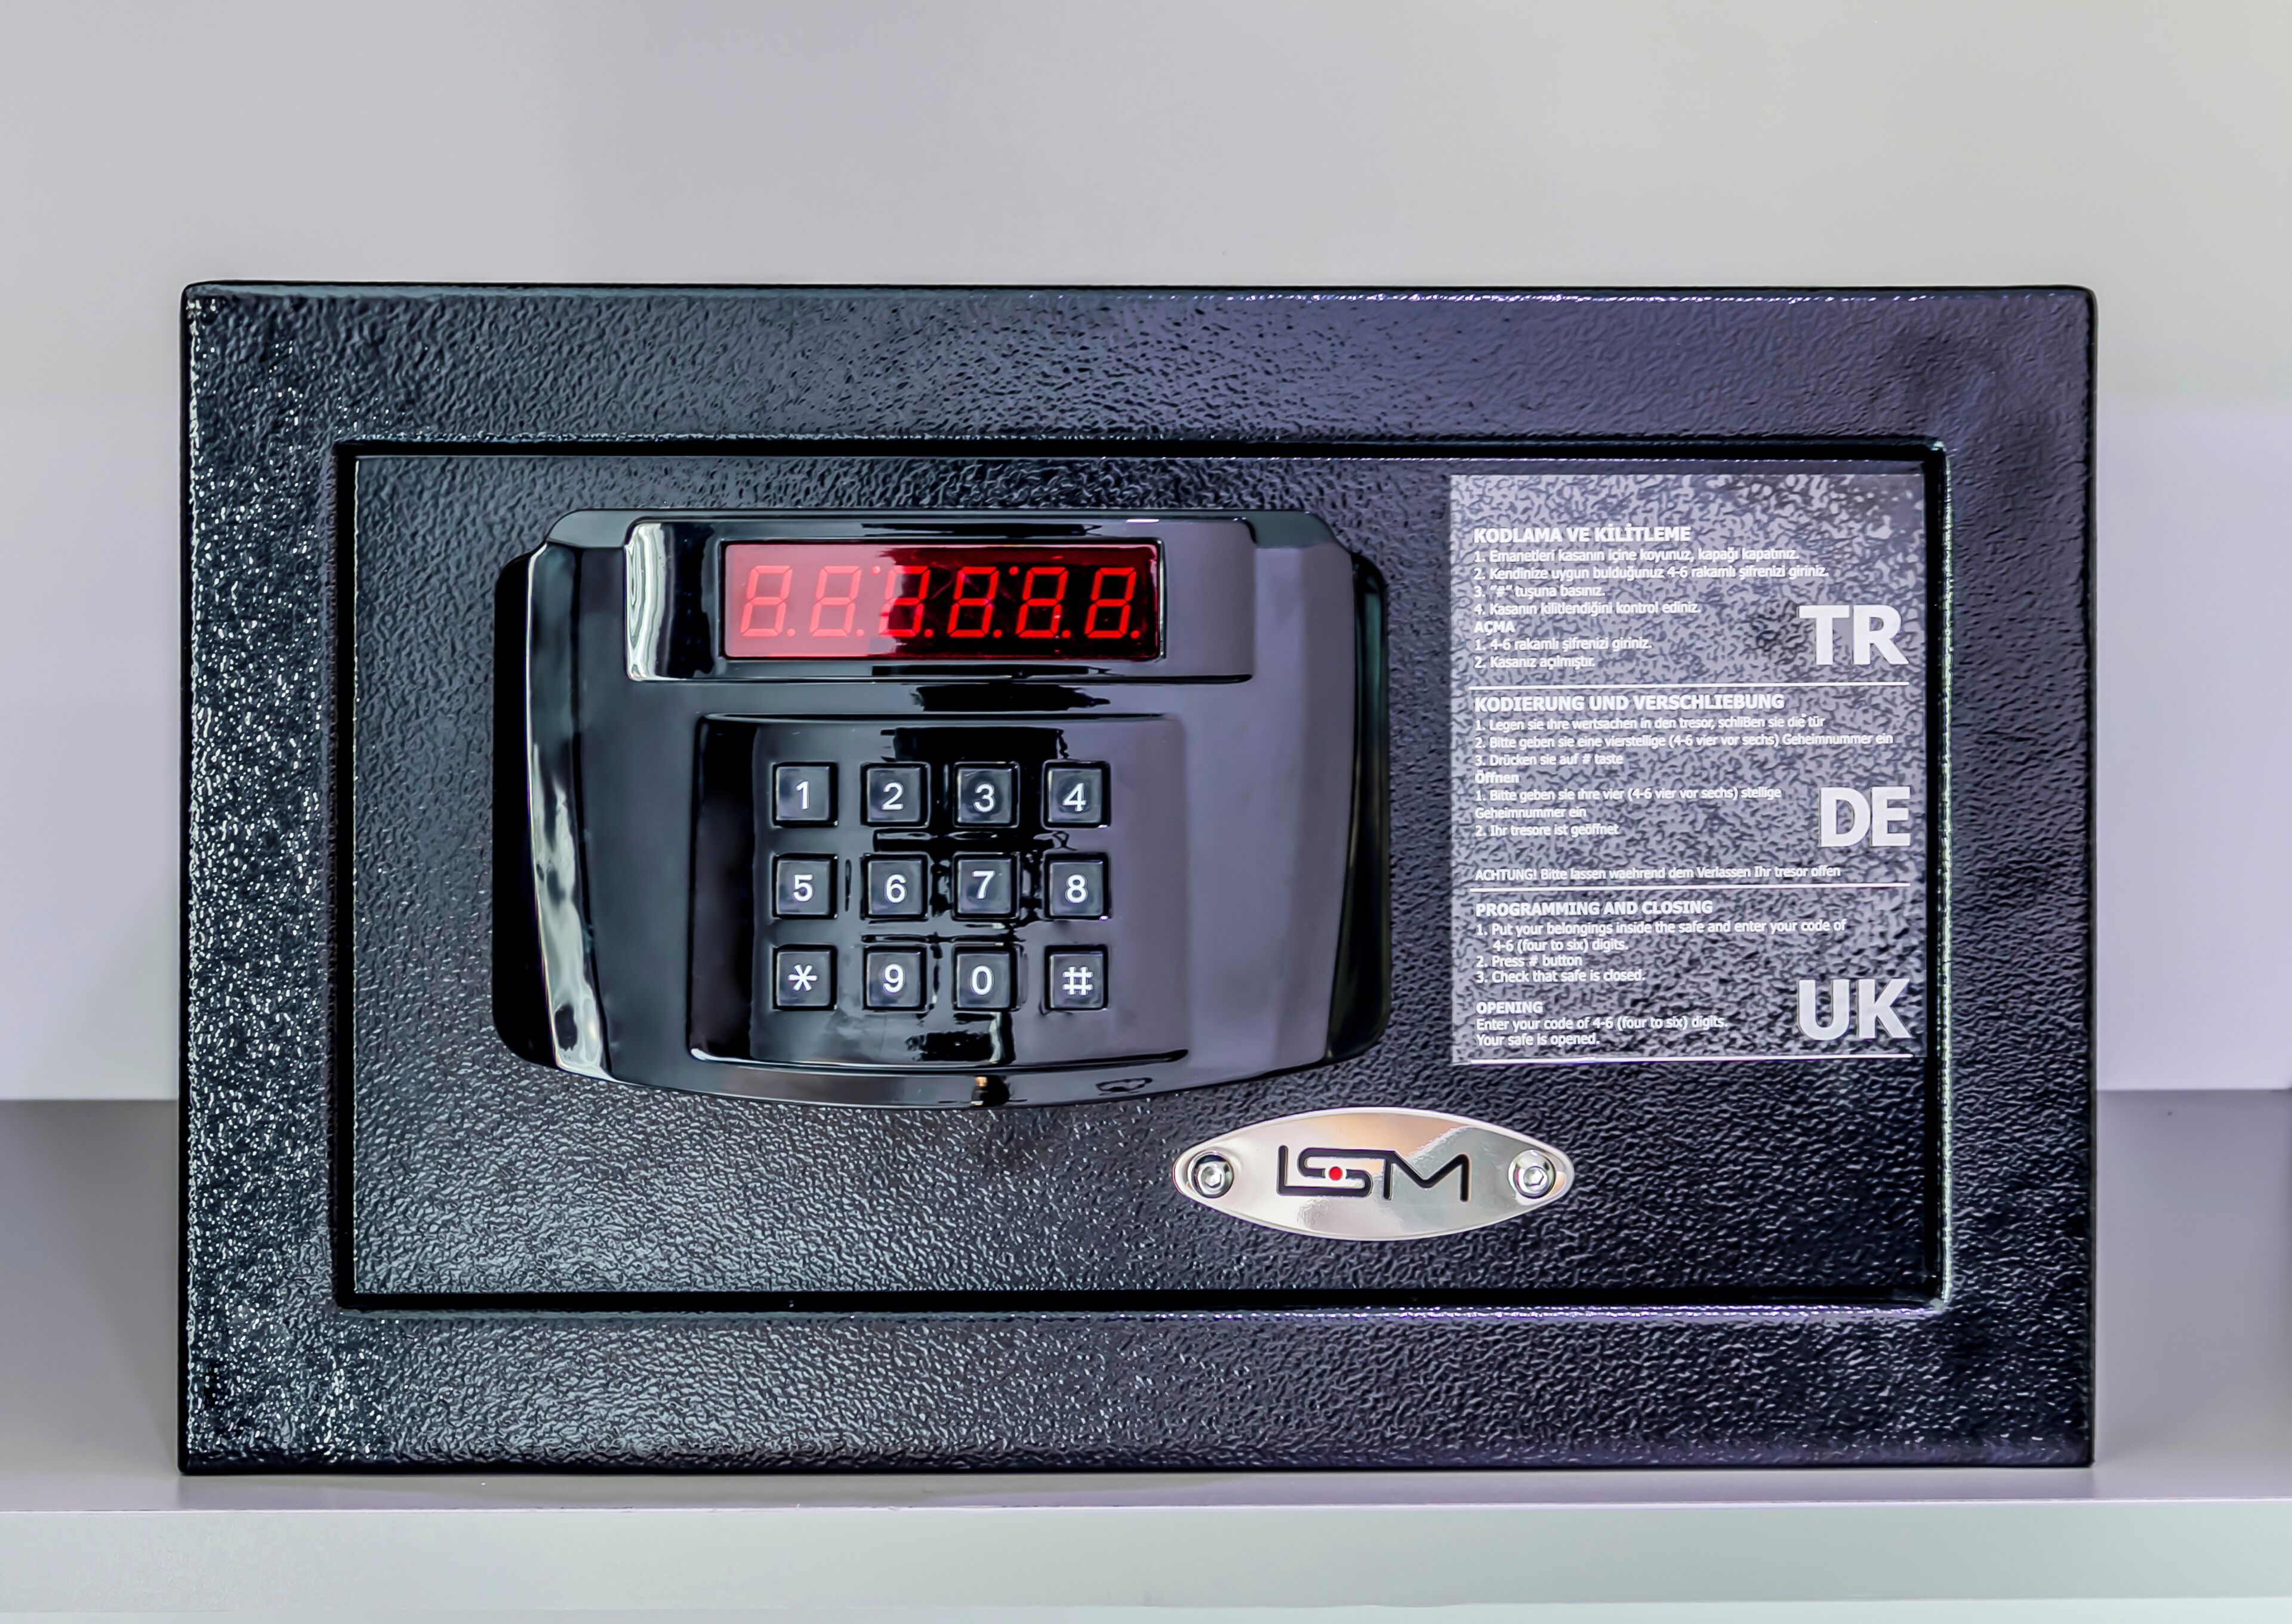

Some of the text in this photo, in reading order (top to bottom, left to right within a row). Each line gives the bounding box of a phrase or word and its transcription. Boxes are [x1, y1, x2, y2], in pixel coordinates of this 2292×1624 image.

[1474, 523, 1691, 543] KODLAMA VE KİLİTLEME
[1474, 551, 1486, 563] 1.
[1490, 550, 1555, 562] Emanetleri
[1609, 550, 1637, 563] içine
[1640, 549, 1694, 563] koyunuz,
[1474, 569, 1486, 580] 2.
[1490, 568, 1548, 580] Kendinize
[1551, 570, 1589, 581] uygun
[1593, 566, 1664, 581] bulduğunuz
[1667, 566, 1688, 578] 4-6
[1739, 566, 1785, 580] şifrenizi
[1789, 566, 1829, 580] giriniz.
[1474, 586, 1486, 598] 3.
[1515, 585, 1557, 599] tuşuna
[1560, 584, 1605, 597] basınız.
[1474, 602, 1701, 617] 4. Kasanın kilitlendiğini kontrol ediniz.
[1474, 621, 1515, 636] AÇMA
[1798, 605, 1909, 665] TR
[1475, 639, 1486, 651] 1.
[1490, 639, 1511, 651] 4-6
[1562, 637, 1609, 652] şifrenizi
[1612, 637, 1652, 651] giriniz.
[1474, 657, 1486, 668] 2.
[1475, 694, 1784, 712] KODIERUNG UND VERSCHLIEBUNG
[1475, 720, 1486, 731] 1.
[1490, 720, 1524, 733] Legen
[1528, 719, 1544, 730] sie
[1572, 717, 1637, 729] wertsachen
[1641, 718, 1652, 729] in
[1655, 717, 1676, 728] den
[1680, 718, 1715, 730] tresor,
[1768, 716, 1784, 728] sie
[1807, 715, 1826, 727] tür
[1475, 733, 1893, 750] 2. Bitte geben sie eine vierstellige (4-6 vier vor sechs) Geheimnummer ein
[1475, 753, 1624, 766] 3. Drücken sie auf # taste
[1475, 770, 1520, 784] Öffnen
[796, 781, 809, 810] 1
[882, 782, 904, 810] 2
[974, 783, 995, 812] 3
[1062, 783, 1086, 812] 4
[1475, 791, 1486, 802] 1.
[1490, 790, 1517, 801] Bitte
[1520, 790, 1555, 803] geben
[1558, 789, 1575, 800] sie
[1603, 788, 1624, 800] vier
[1628, 788, 1652, 802] (4-6
[1655, 788, 1676, 799] vier
[1680, 790, 1698, 799] vor
[1702, 787, 1738, 800] sechs)
[1741, 787, 1781, 801] stellige
[1475, 807, 1586, 819] Geheimnummer ein
[1820, 787, 1910, 847] DE
[1475, 823, 1619, 837] 2. Ihr tresore ist geöffnet
[1475, 865, 1841, 881] ACHTUNG! Bitte lassen waehrend dem Verlassen Ihr tresor offen
[793, 874, 814, 902] 5
[885, 874, 907, 903] 6
[972, 871, 994, 899] 7
[1065, 874, 1088, 904] 8
[1475, 900, 1713, 917] PROGRAMMING AND CLOSING
[1477, 919, 1847, 937] 1. Put your belongings inside the safe and enter your code of
[1492, 939, 1628, 954] 4-6 (four to six) digits.
[1476, 954, 1583, 967] 2. Press # button
[883, 964, 904, 993] 9
[971, 966, 993, 995] 0
[1062, 966, 1093, 995] #
[1476, 969, 1646, 983] 3. Check that safe is closed.
[1475, 1001, 1544, 1014] OPENING
[1798, 978, 1911, 1040] UK
[1476, 1016, 1728, 1031] Enter your code of 4-6 (four to six) digits.
[1476, 1033, 1600, 1046] Your safe is opened.
